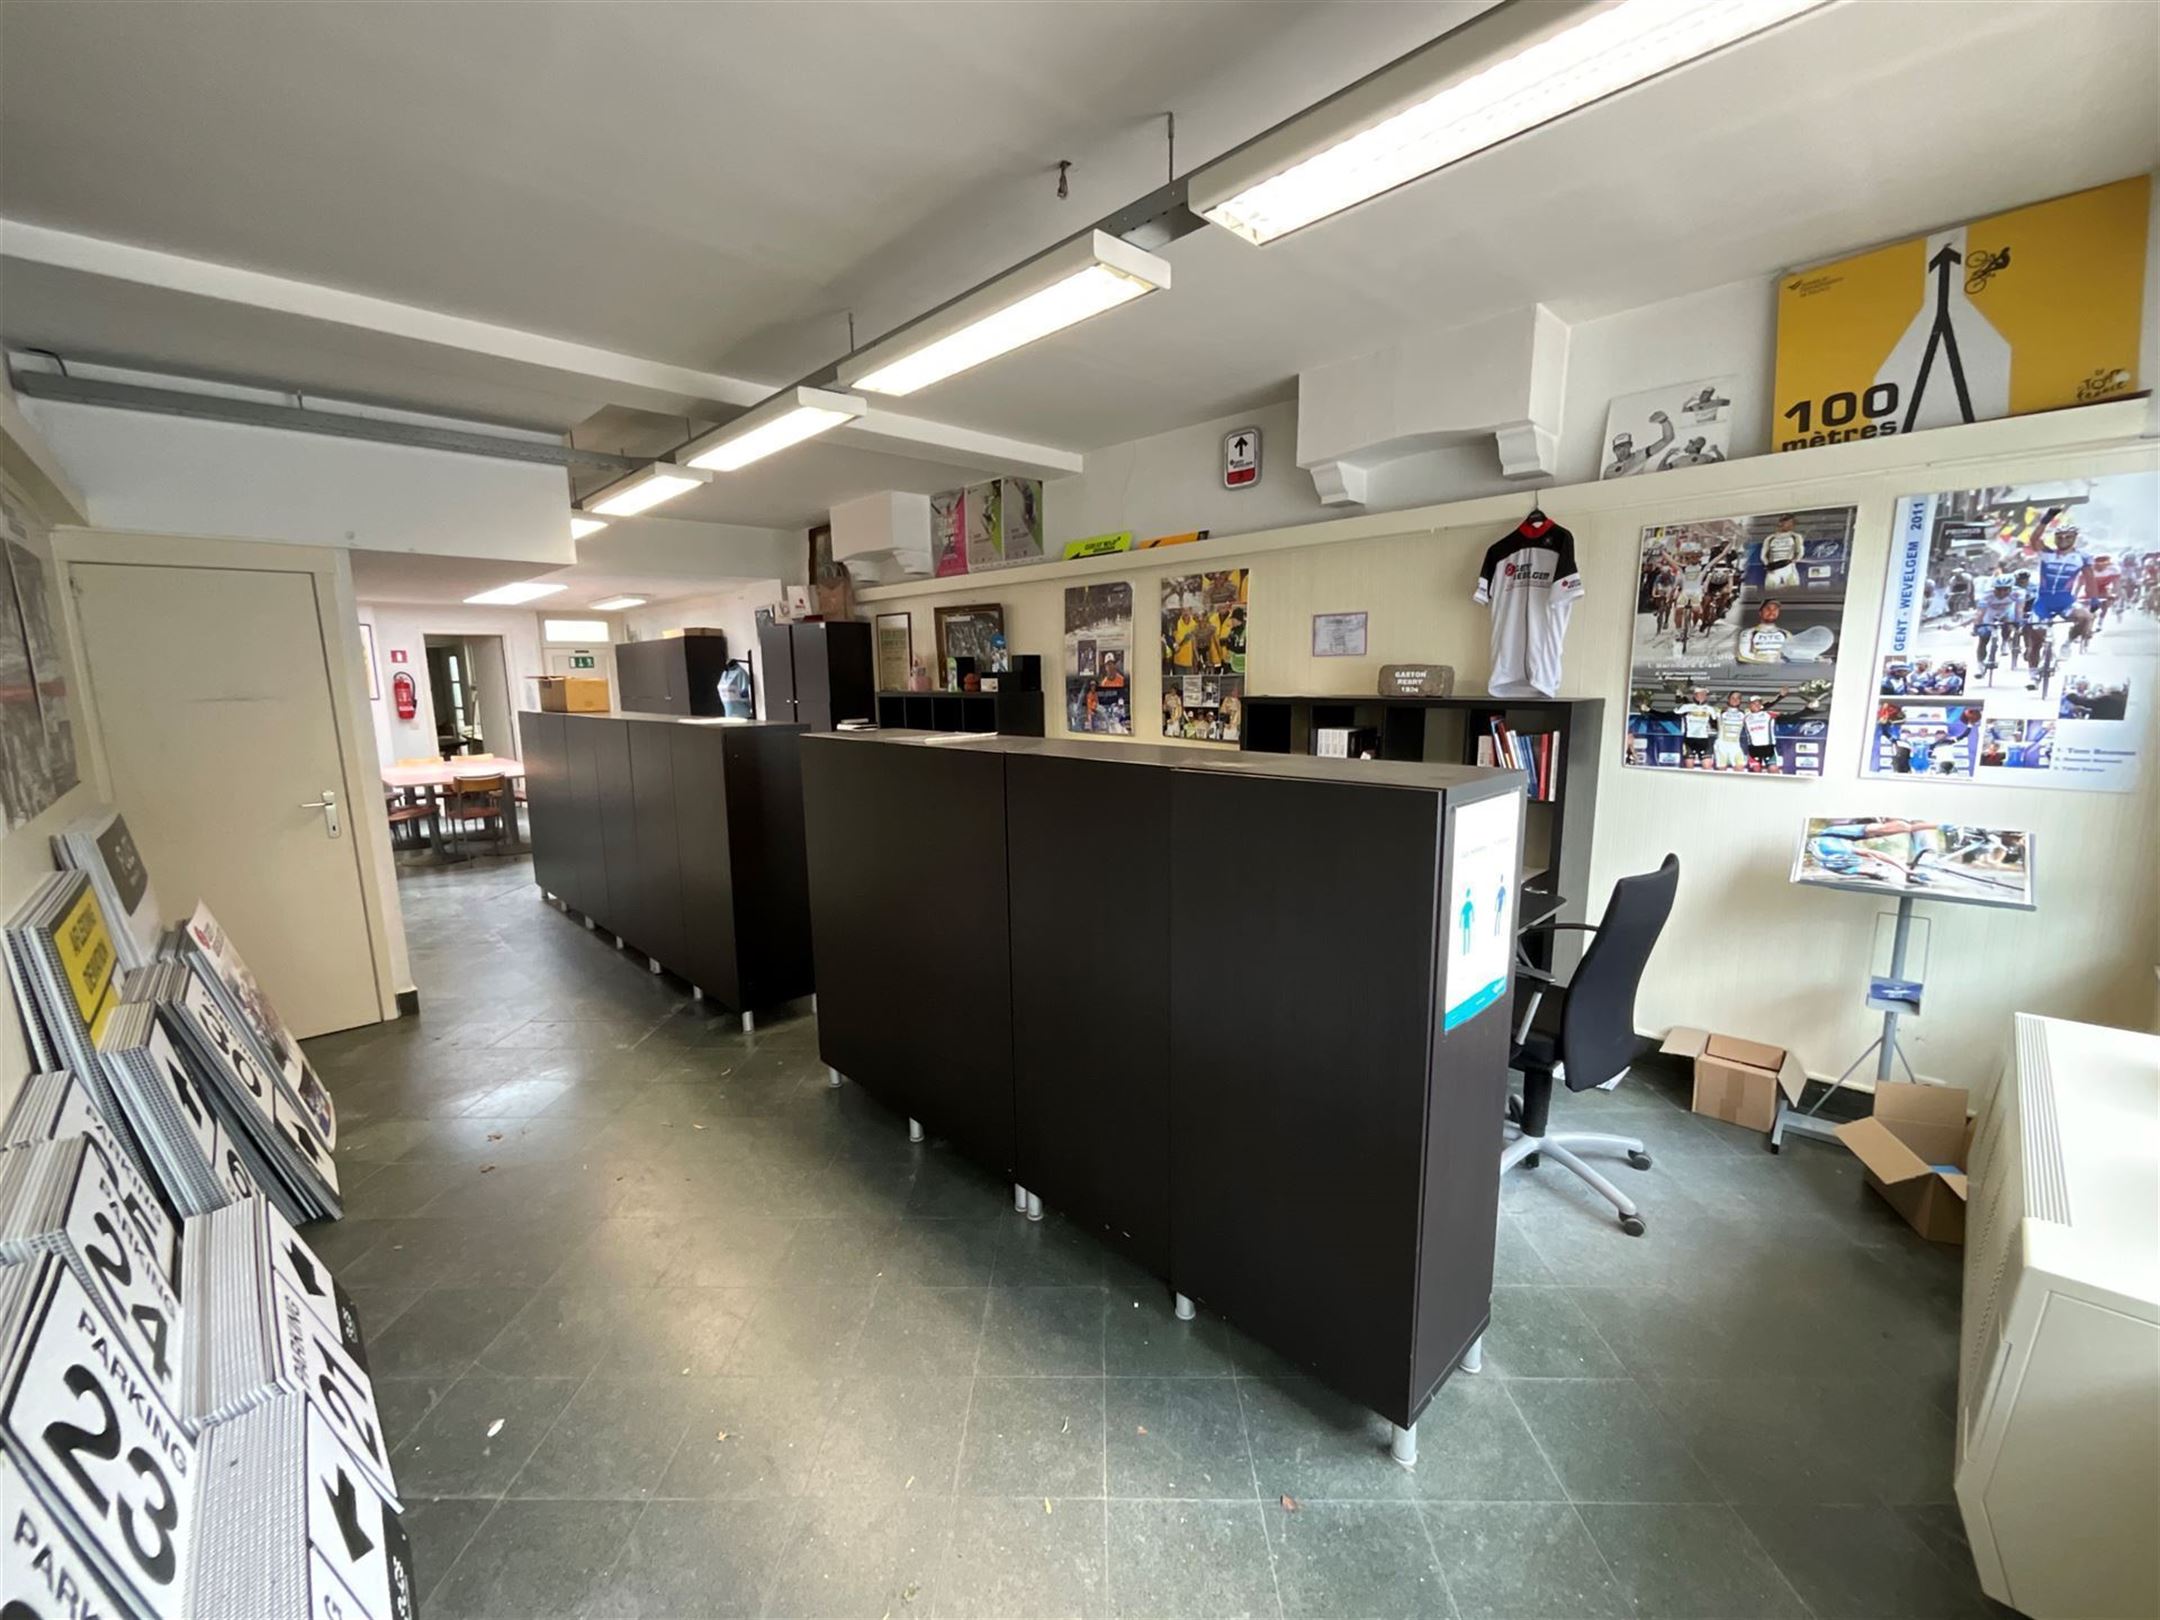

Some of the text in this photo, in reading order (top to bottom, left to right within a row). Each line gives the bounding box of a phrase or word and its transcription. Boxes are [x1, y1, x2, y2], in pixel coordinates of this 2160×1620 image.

[1782, 421, 1898, 452] mètres
[1784, 383, 1899, 433] 100
[1910, 502, 1925, 531] 2011
[1900, 541, 1920, 610] WEVELGEM
[1893, 619, 1908, 652] GENT
[86, 1104, 162, 1226] PARKING
[99, 1176, 176, 1321] PARKING
[84, 1211, 172, 1385] 24
[77, 1307, 187, 1479] PARKING
[42, 1363, 179, 1586] 23
